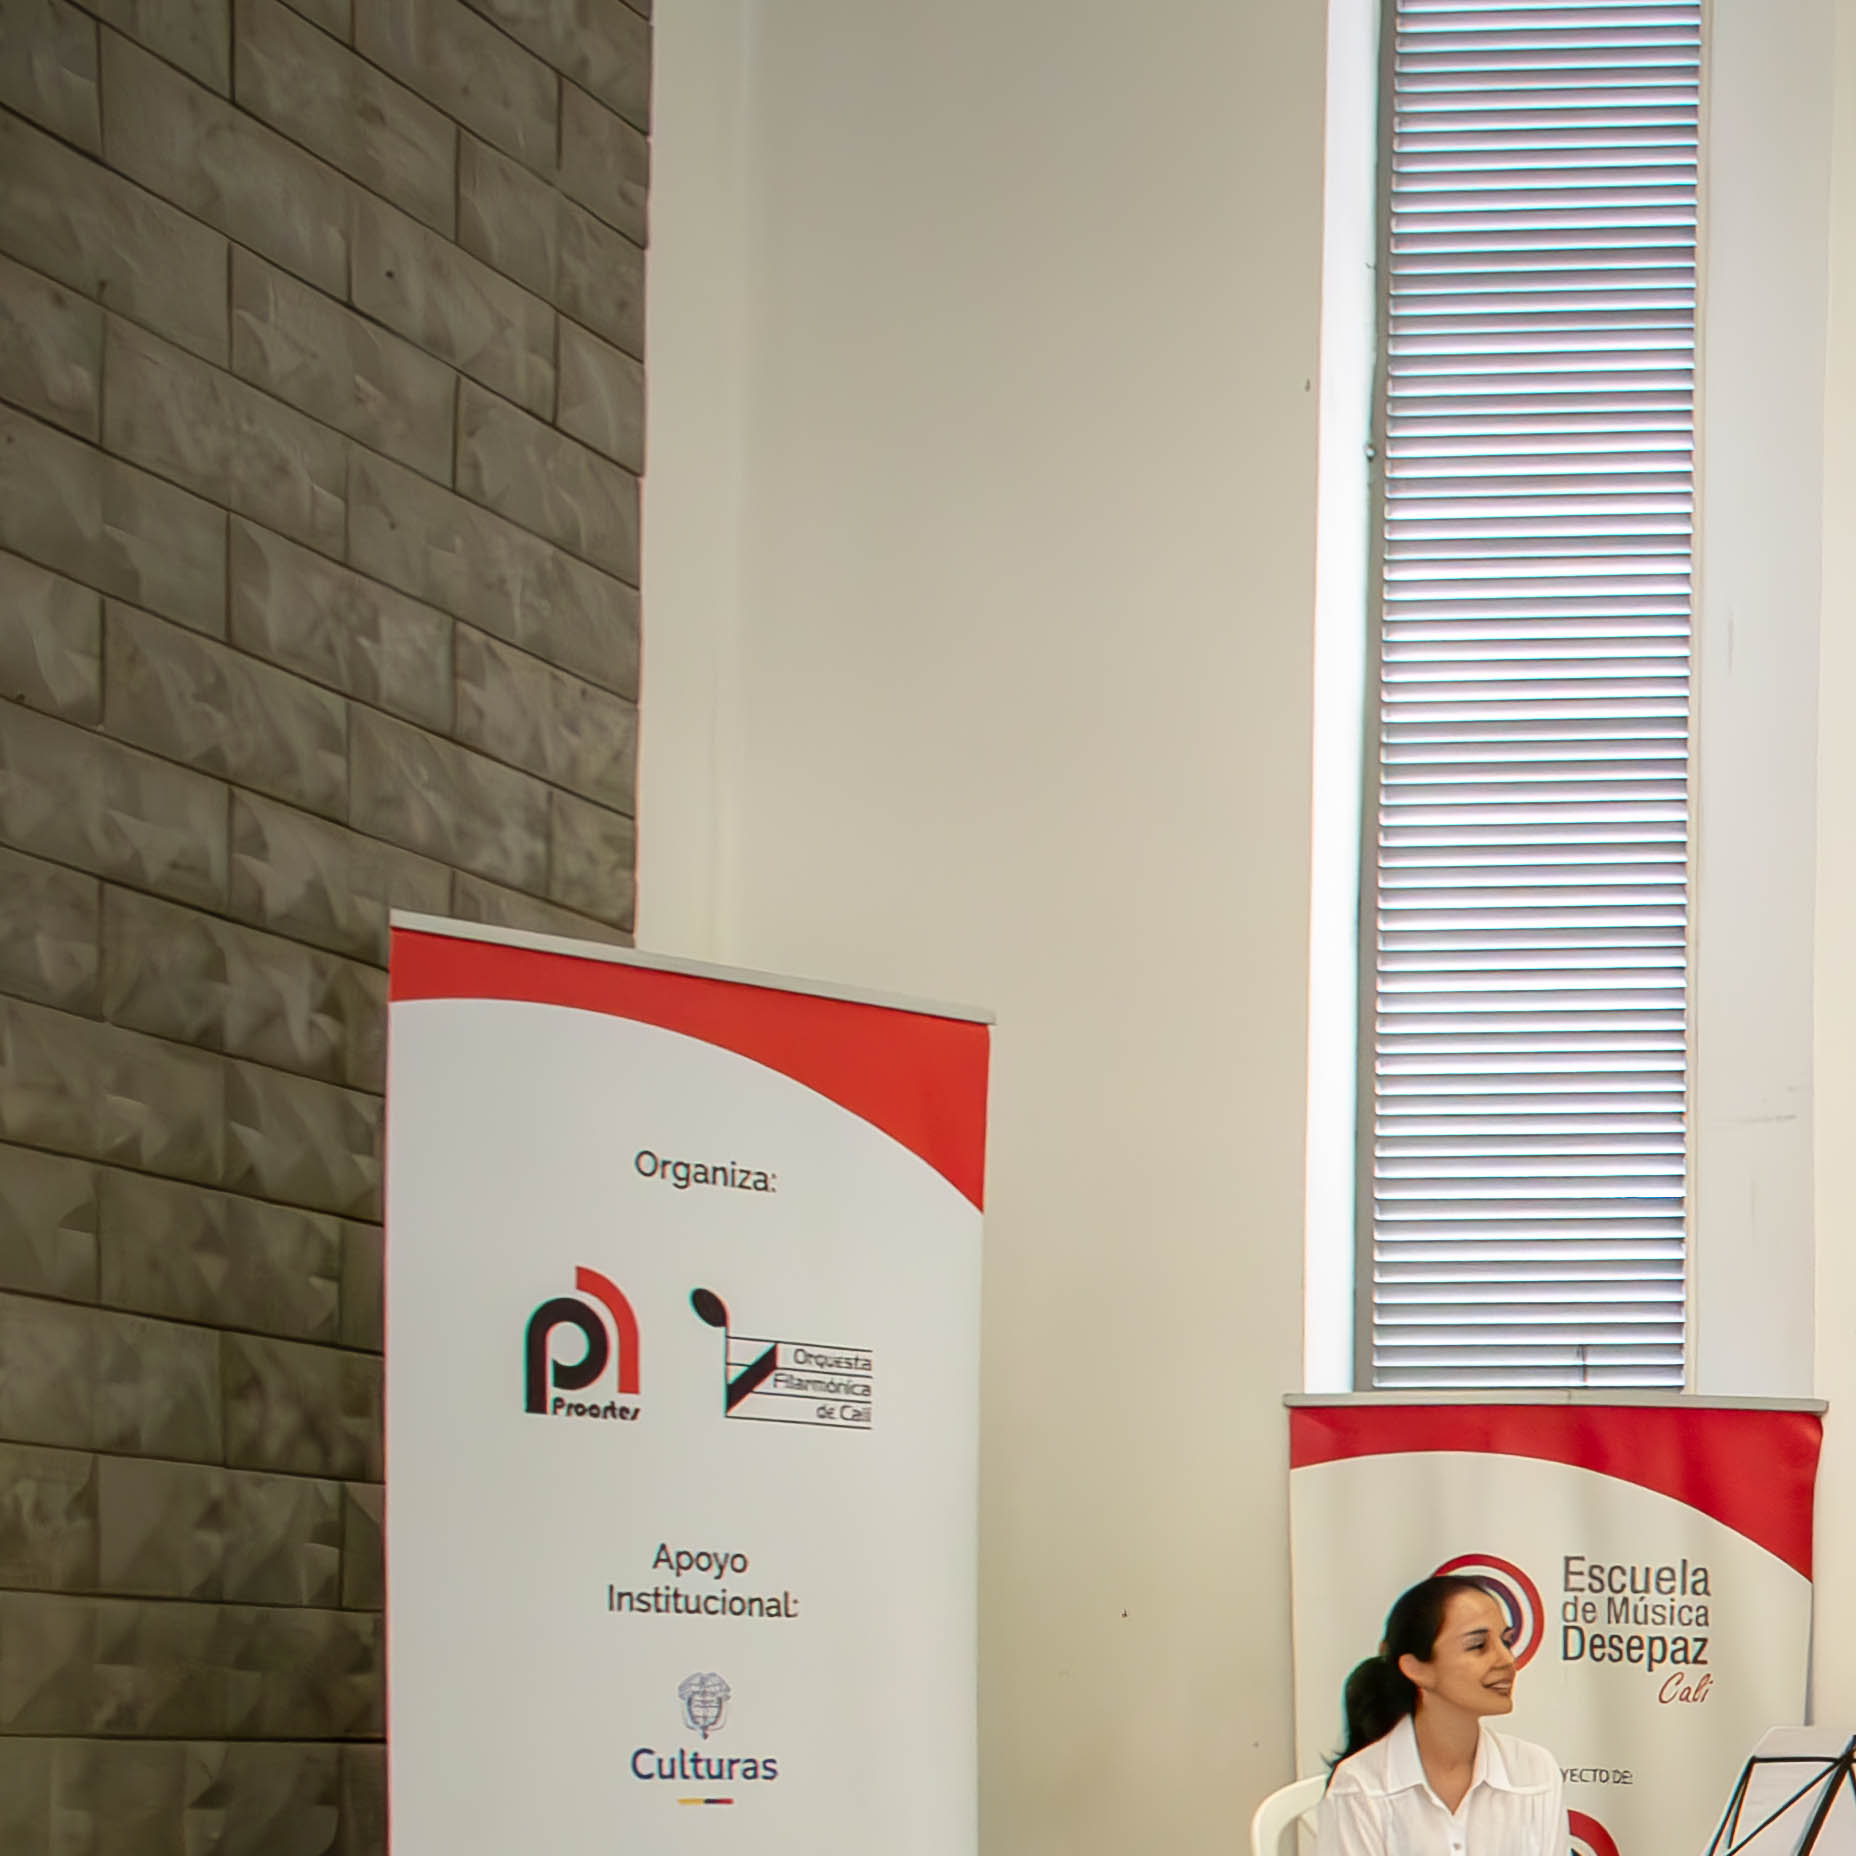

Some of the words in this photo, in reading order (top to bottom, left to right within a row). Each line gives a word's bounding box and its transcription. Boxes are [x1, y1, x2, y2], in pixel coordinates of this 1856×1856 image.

[635, 1150, 777, 1193] Organiza:
[793, 1348, 872, 1371] Orquesta
[552, 1397, 640, 1421] Proartes
[652, 1543, 750, 1580] Apoyo
[1563, 1555, 1712, 1597] Escuela
[608, 1584, 800, 1619] Institucional:
[1562, 1595, 1597, 1624] de
[1607, 1596, 1710, 1627] Música
[1562, 1625, 1709, 1673] Desepaz
[1658, 1671, 1714, 1704] Cali
[631, 1747, 779, 1781] Culturas
[1560, 1768, 1610, 1784] YECTO
